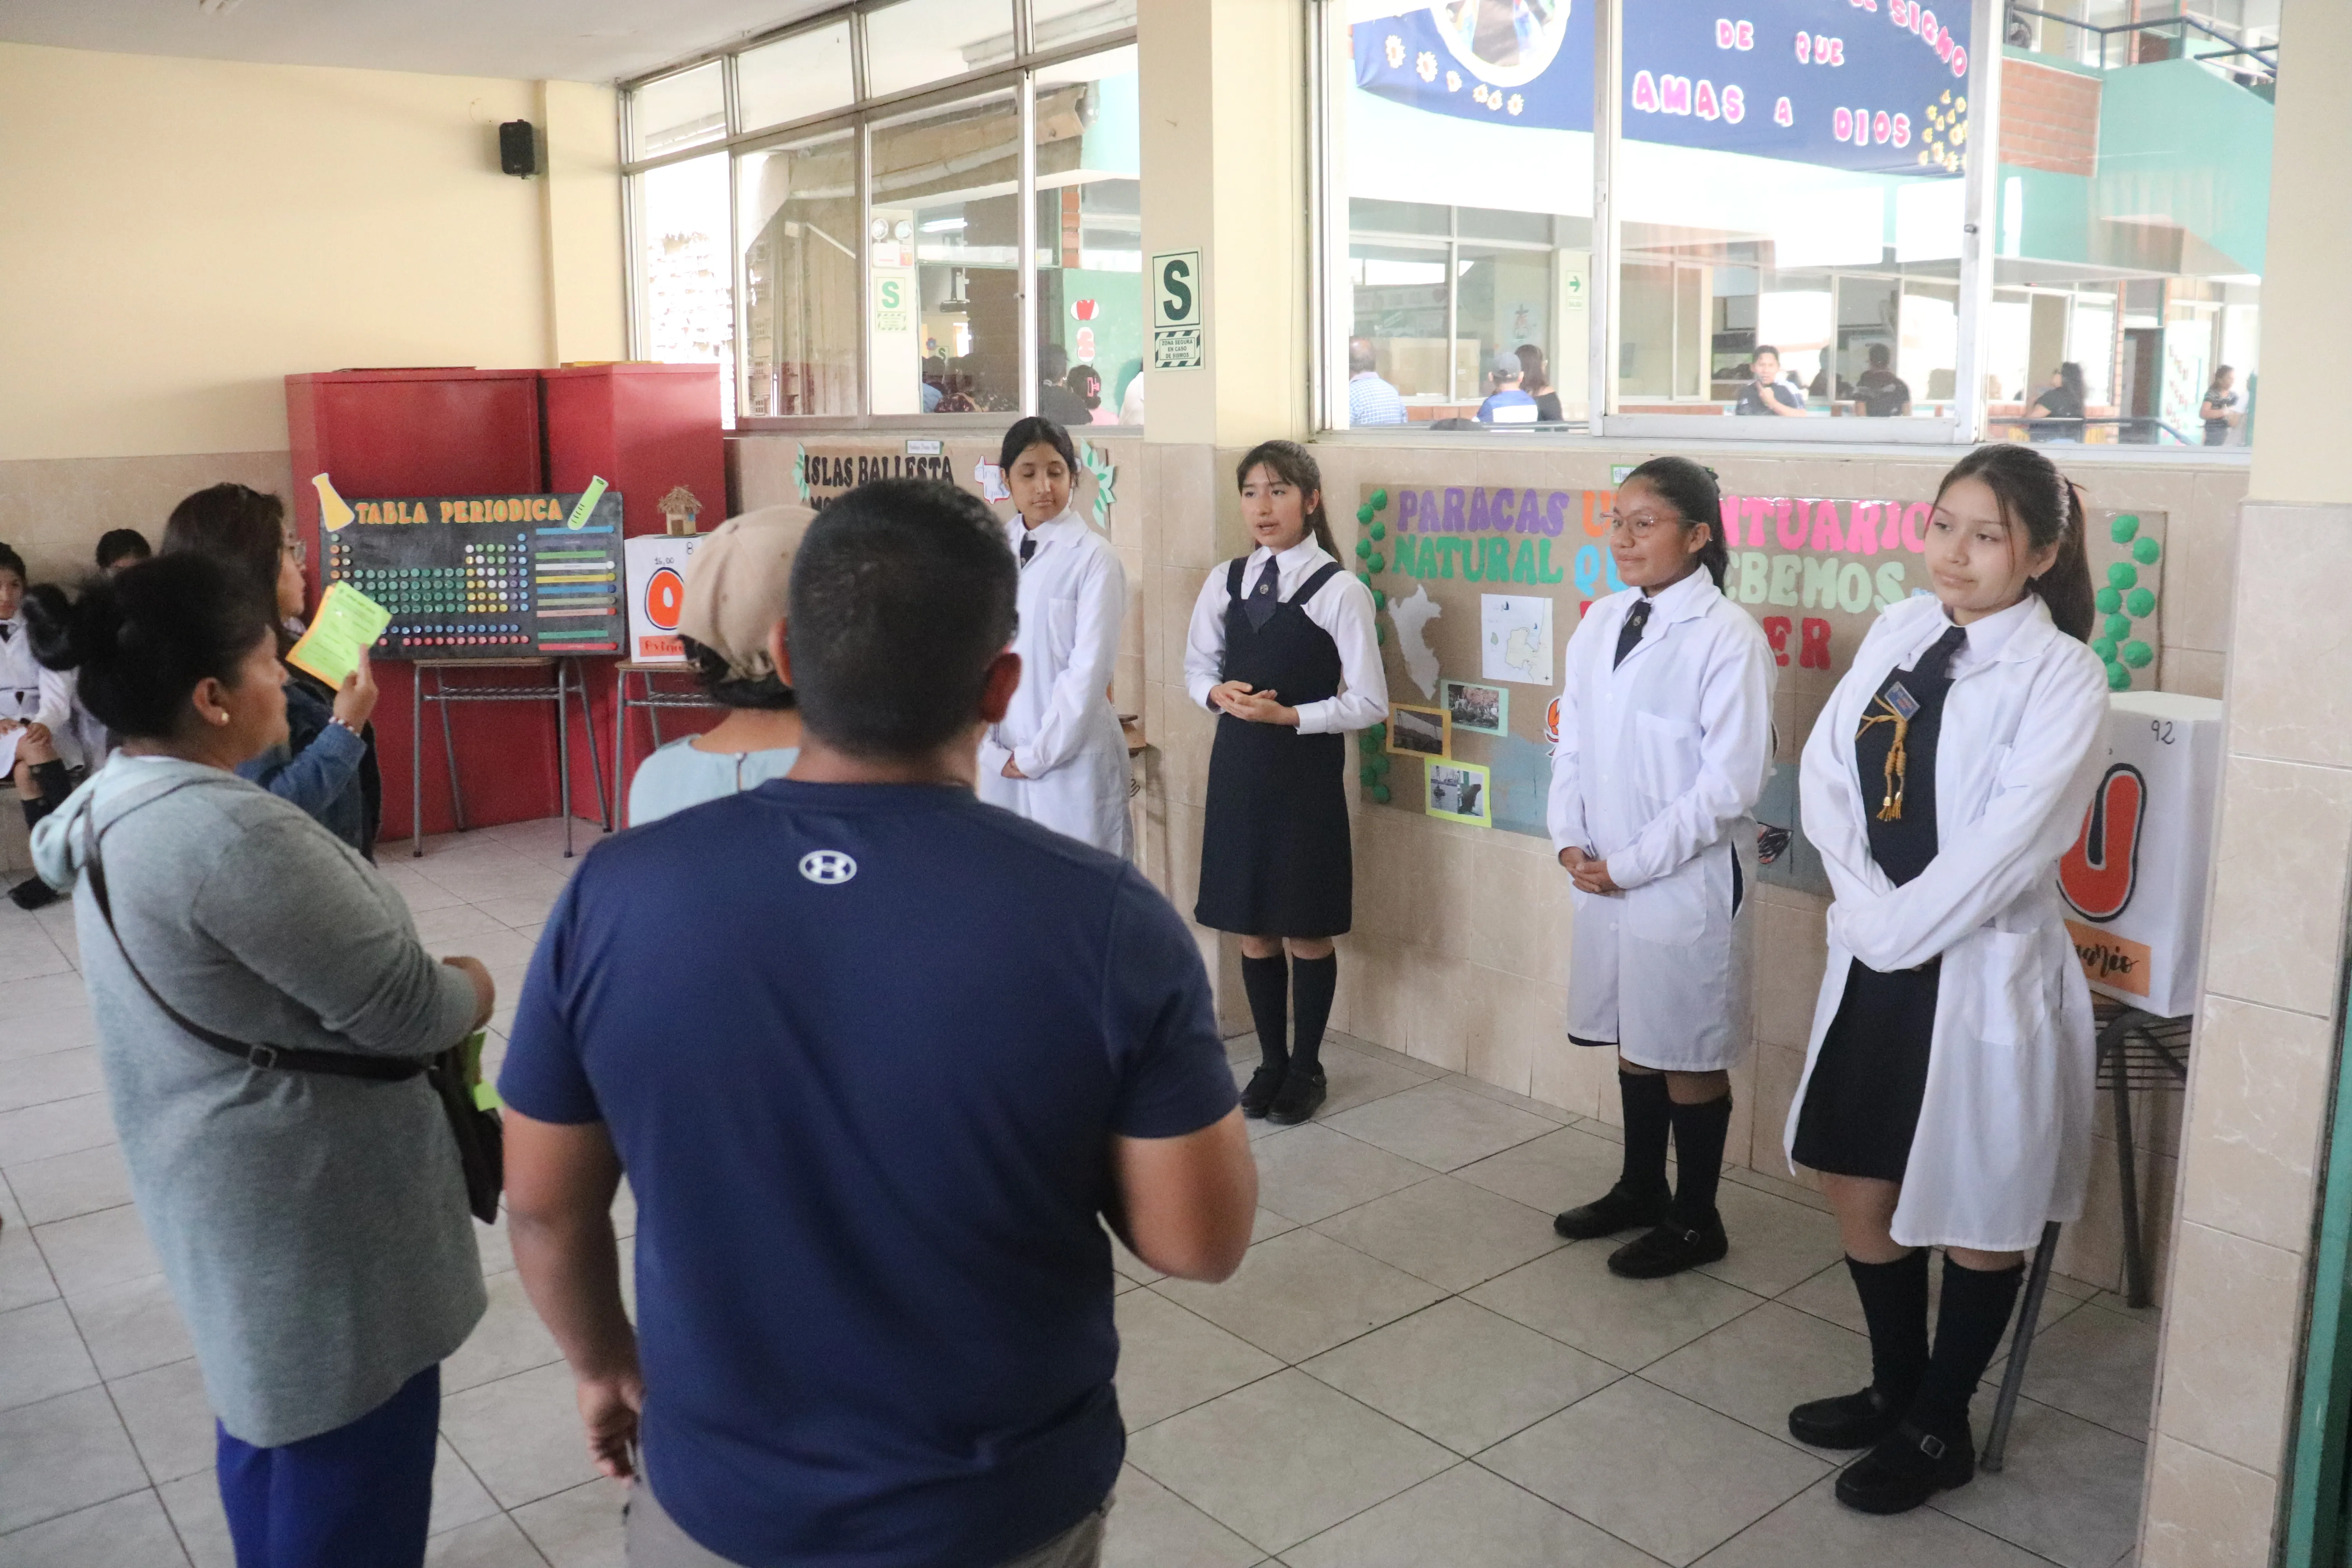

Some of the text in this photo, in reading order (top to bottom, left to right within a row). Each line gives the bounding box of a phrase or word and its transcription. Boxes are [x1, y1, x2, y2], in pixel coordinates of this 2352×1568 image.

[1715, 19, 1844, 66] DE QUE
[1632, 71, 1911, 148] AMAS A DIOS
[882, 281, 900, 309] S
[1163, 260, 1191, 321] S
[804, 455, 853, 487] ISLAS
[355, 499, 563, 524] TABLA PERIODICA
[1397, 487, 1570, 537] PARACAS
[687, 542, 693, 555] 8
[1392, 534, 1564, 585] NATURAL
[2151, 720, 2175, 745] 92
